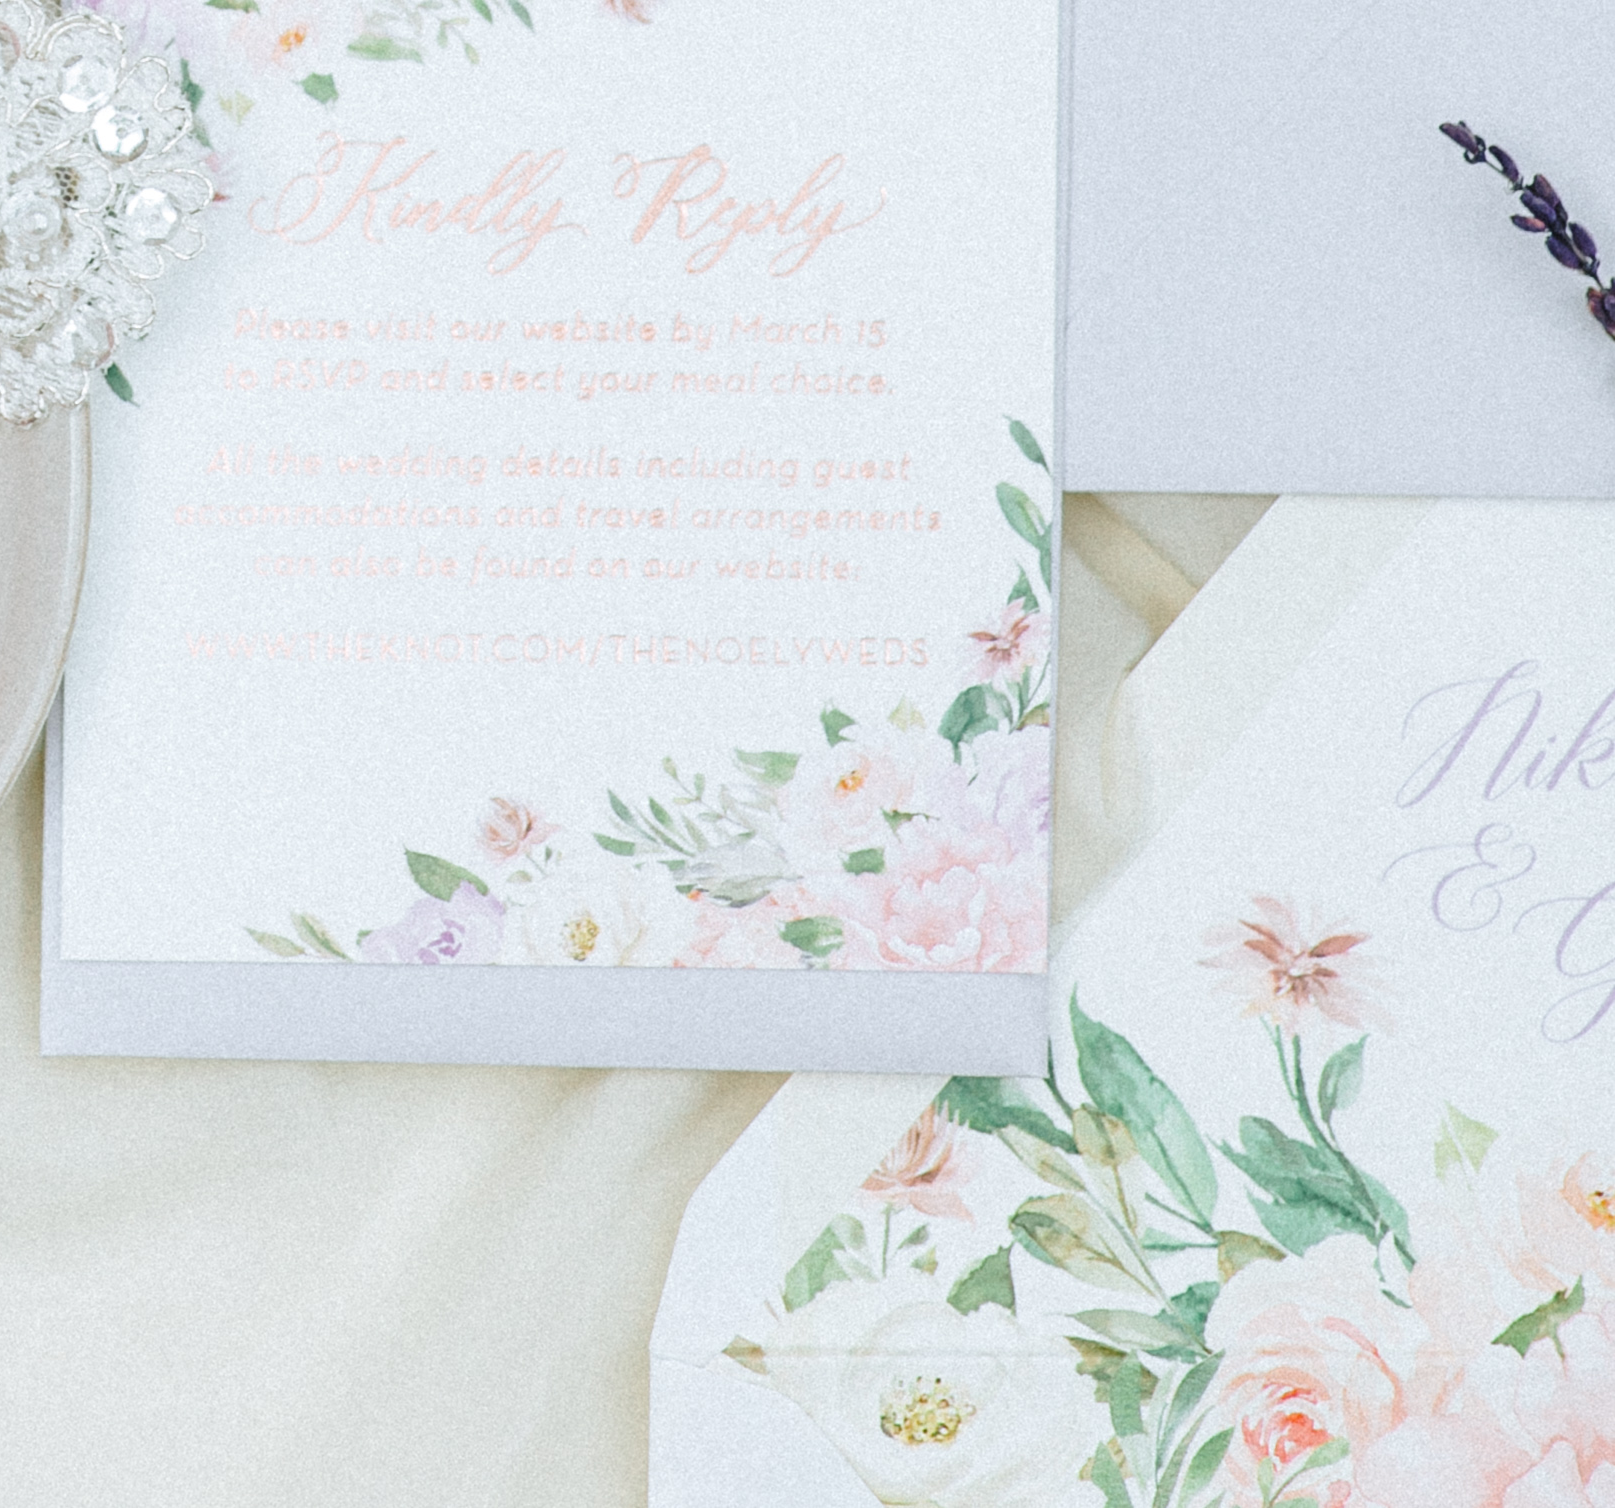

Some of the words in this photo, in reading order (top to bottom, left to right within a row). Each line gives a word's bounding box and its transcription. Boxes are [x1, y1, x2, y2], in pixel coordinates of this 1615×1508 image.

[247, 130, 590, 277] Kindly
[612, 142, 889, 279] Reply
[233, 307, 351, 342] Please
[366, 311, 438, 342] visit
[449, 318, 507, 342] our
[522, 309, 658, 344] website
[671, 311, 716, 352] by
[729, 313, 843, 346] March
[856, 318, 888, 350] 15
[222, 362, 259, 391] to
[271, 359, 370, 391] RSVP
[380, 360, 449, 393] and
[459, 361, 565, 393] select
[577, 371, 658, 402] your
[671, 362, 760, 395] meal
[771, 362, 896, 397] choice.
[207, 443, 256, 476] All
[267, 443, 323, 476] the
[337, 444, 489, 486] wedding
[502, 445, 622, 480] details
[636, 445, 800, 489] including
[812, 451, 912, 489] guest
[173, 495, 481, 528] accommodations
[494, 497, 564, 529] and
[576, 497, 680, 531] travel
[691, 503, 943, 539] arrangements
[254, 553, 317, 578] can
[331, 544, 403, 579] also
[416, 545, 458, 579] be
[469, 544, 576, 586] found
[586, 555, 630, 581] on
[643, 556, 700, 582] our
[185, 631, 929, 668] WWW.THEKNOT.COM/THENOELYWEDS
[1380, 822, 1537, 932] &
